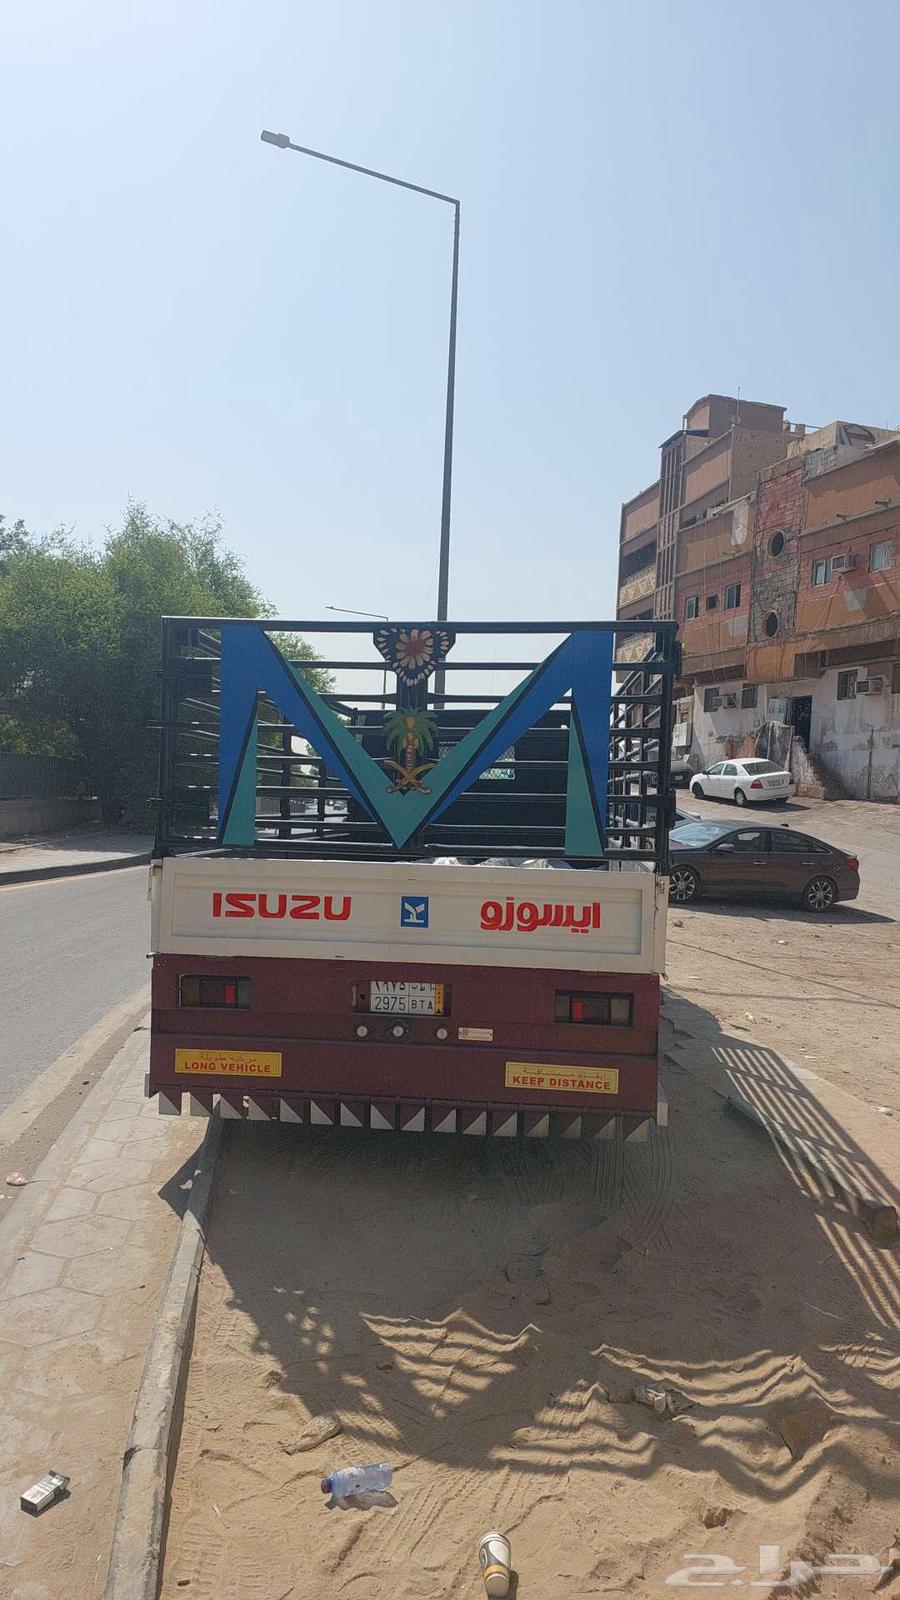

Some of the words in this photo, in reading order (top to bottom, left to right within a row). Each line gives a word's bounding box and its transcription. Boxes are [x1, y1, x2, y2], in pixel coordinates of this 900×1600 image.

[212, 892, 352, 920] ISUZU
[480, 896, 601, 933] ايسوزو
[375, 996, 405, 1011] 2975
[184, 1062, 216, 1071] LONG
[221, 1063, 271, 1073] VEHICLE
[512, 1075, 544, 1085] KEEP
[549, 1078, 611, 1090] DISTANCE
